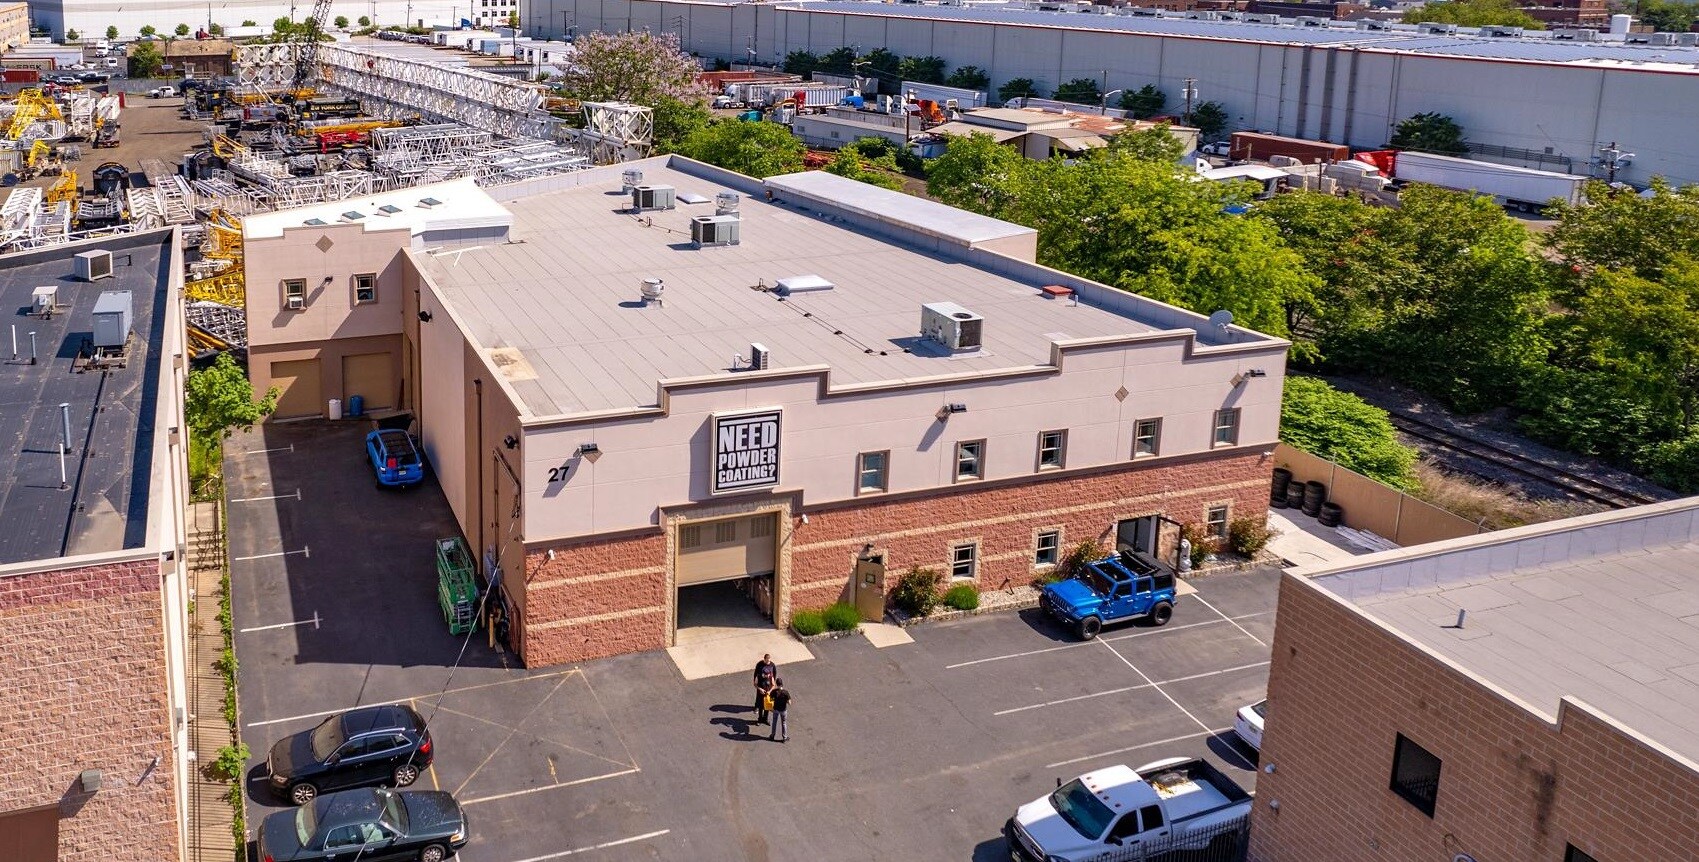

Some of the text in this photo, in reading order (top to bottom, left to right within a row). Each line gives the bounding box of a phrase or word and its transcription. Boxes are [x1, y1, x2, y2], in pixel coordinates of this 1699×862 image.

[719, 421, 777, 453] NEED
[719, 447, 777, 470] POWDER
[548, 465, 570, 483] 27
[718, 464, 776, 483] COATING?
